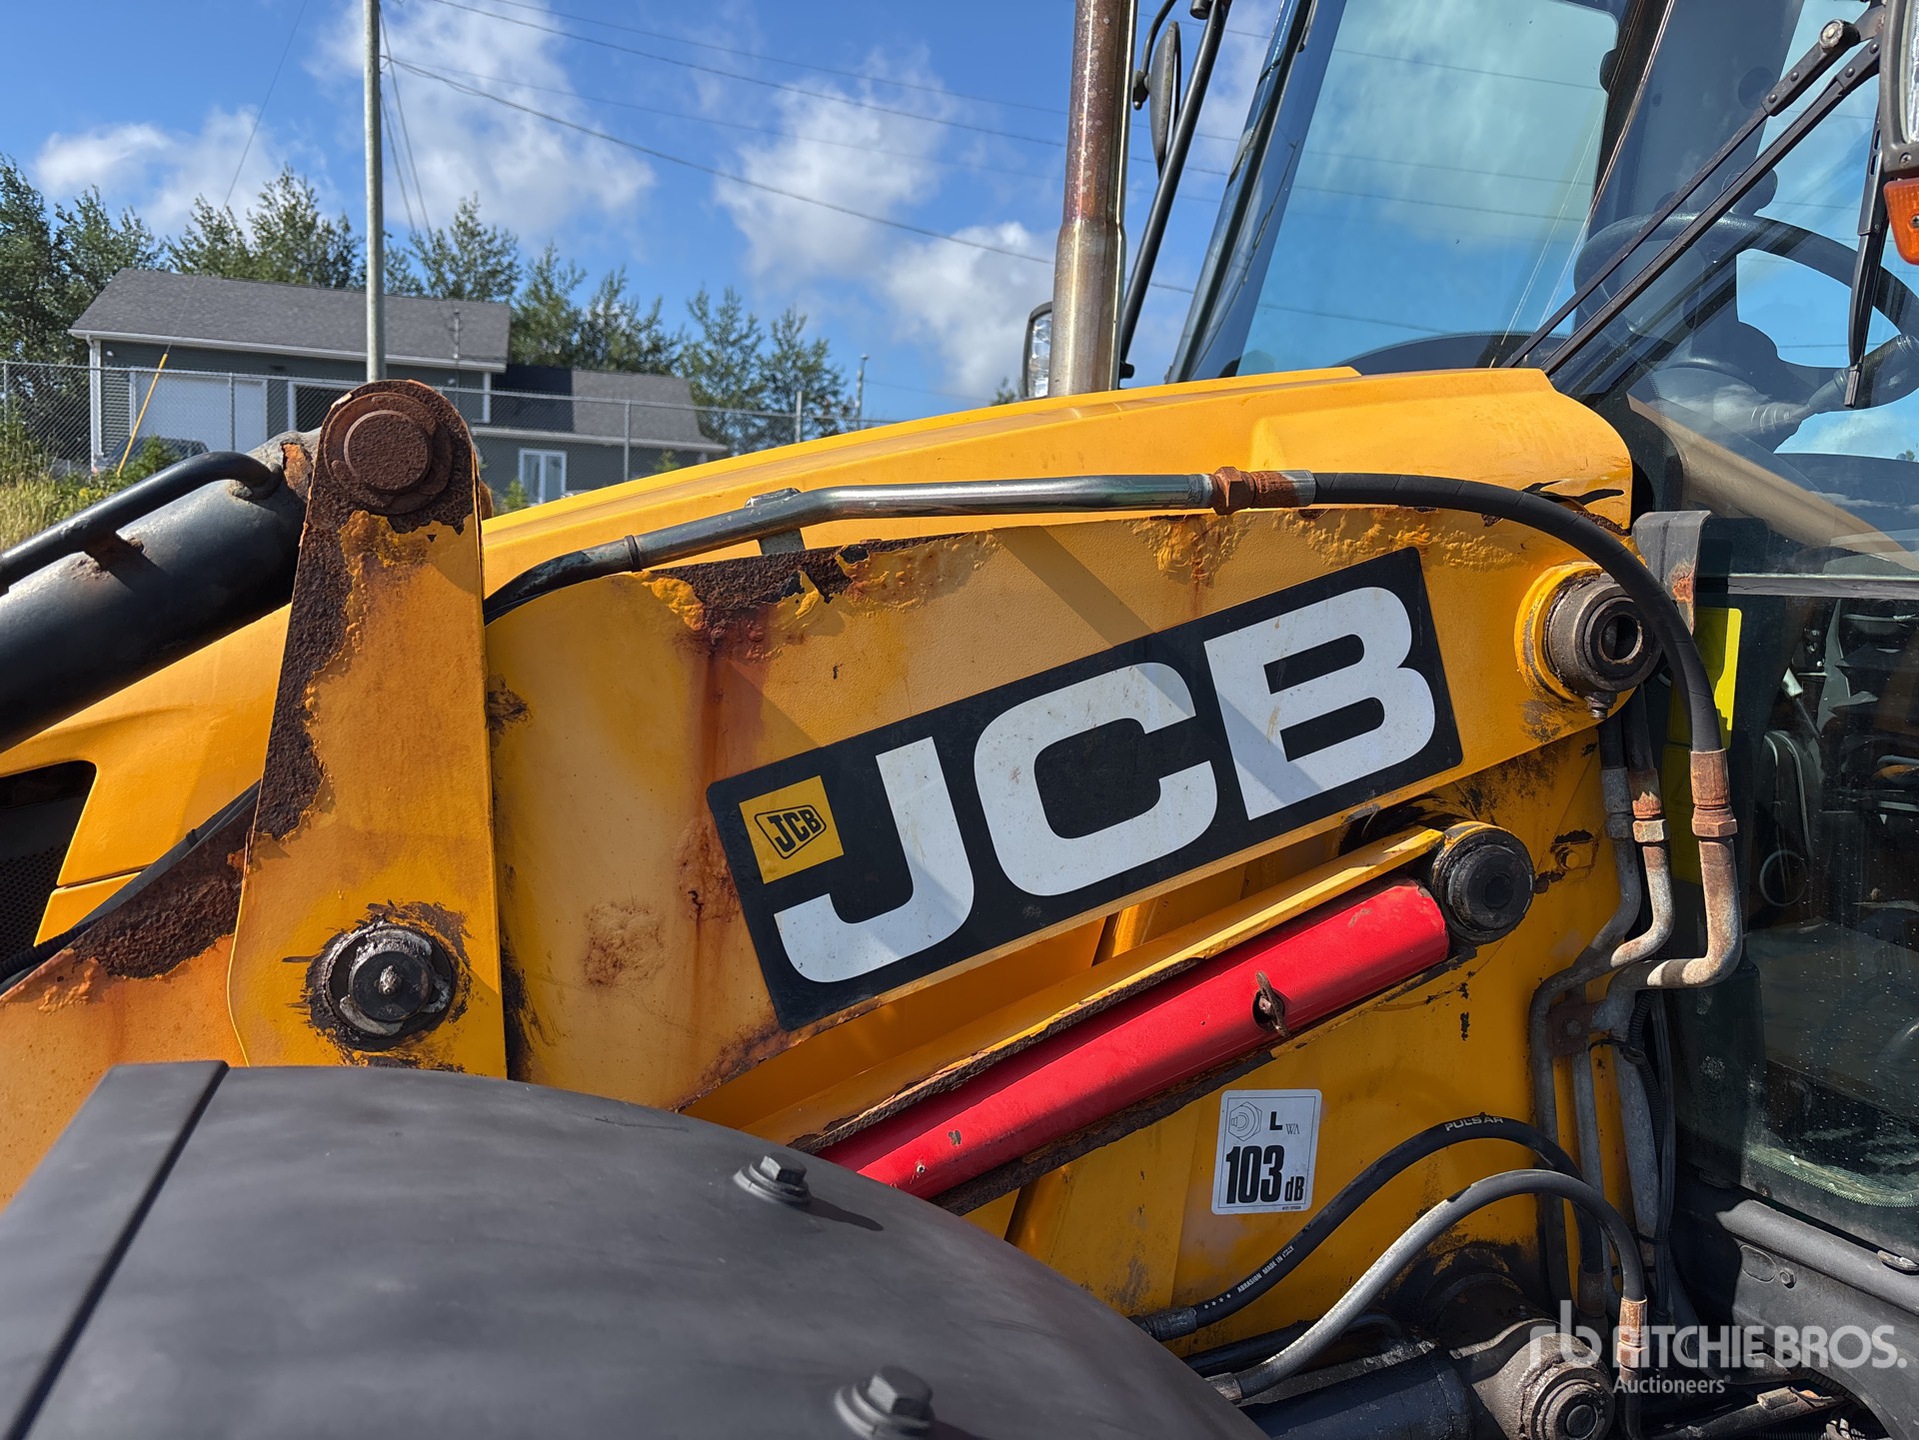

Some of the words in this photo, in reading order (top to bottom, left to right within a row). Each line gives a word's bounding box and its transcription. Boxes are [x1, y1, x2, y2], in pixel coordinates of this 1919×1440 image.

[773, 585, 1436, 984] JCB
[767, 809, 821, 852] JCB
[1444, 1116, 1504, 1132] PULSAR
[1226, 1145, 1284, 1204] 103
[1284, 1176, 1305, 1202] dB
[1236, 1272, 1263, 1293] ABRASION
[1261, 1260, 1277, 1275] MADE
[1275, 1255, 1283, 1264] IN
